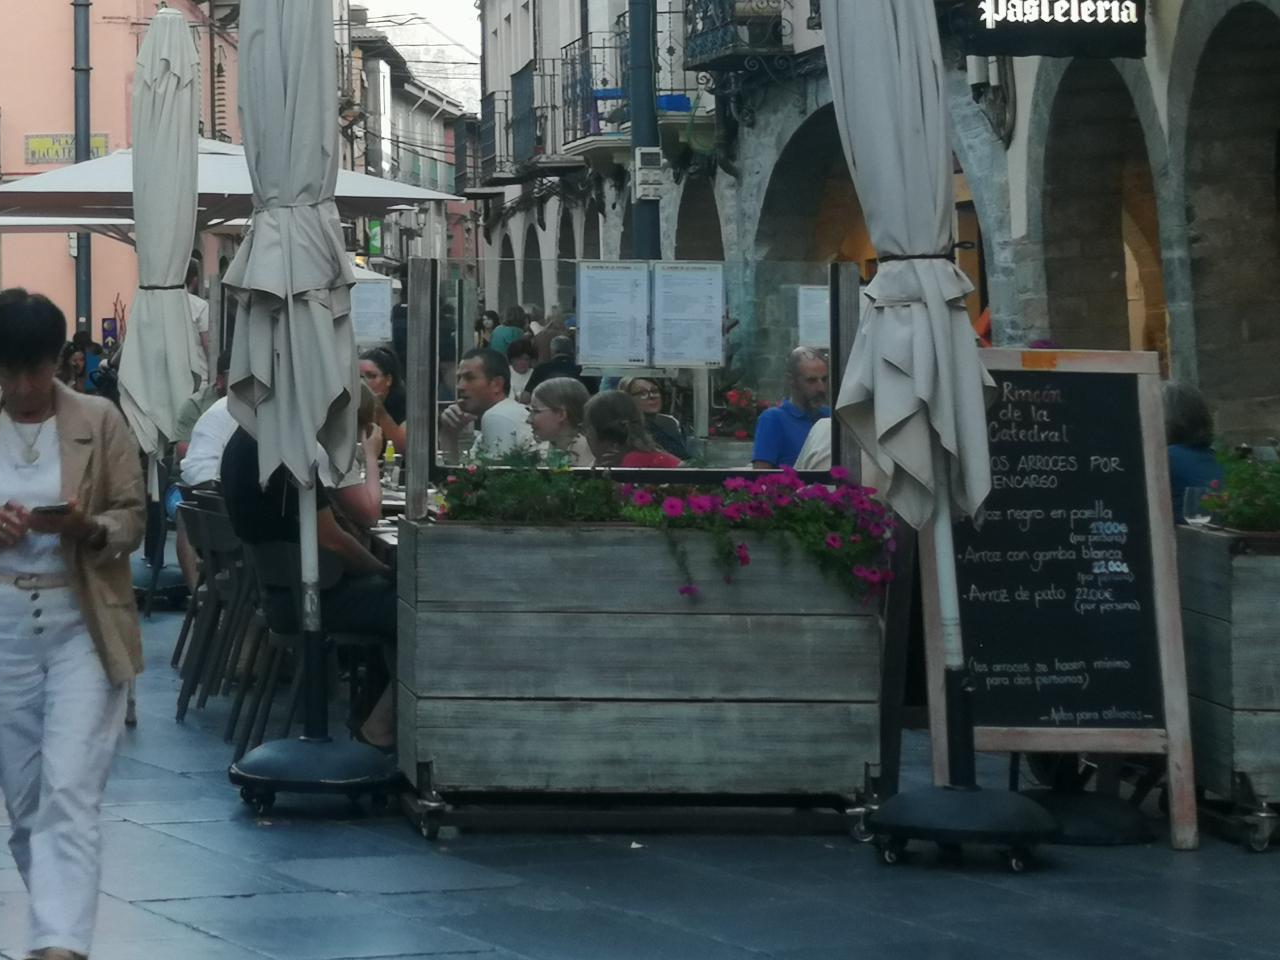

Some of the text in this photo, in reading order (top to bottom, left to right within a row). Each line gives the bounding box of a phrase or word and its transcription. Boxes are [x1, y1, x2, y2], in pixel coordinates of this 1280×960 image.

[1003, 382, 1062, 402] Rincón
[999, 403, 1051, 422] de la
[988, 421, 1070, 442] Catedral
[991, 455, 1126, 472] OS ARROCES POR
[993, 474, 1058, 489] ENCARGO
[985, 500, 1113, 533] oz negro en paella
[965, 545, 1123, 572] Arroz con gamba blanca
[969, 584, 1011, 602] Arroz
[1015, 584, 1030, 600] de
[1034, 584, 1067, 608] pato
[992, 662, 1030, 672] arroces
[985, 676, 1010, 691] para
